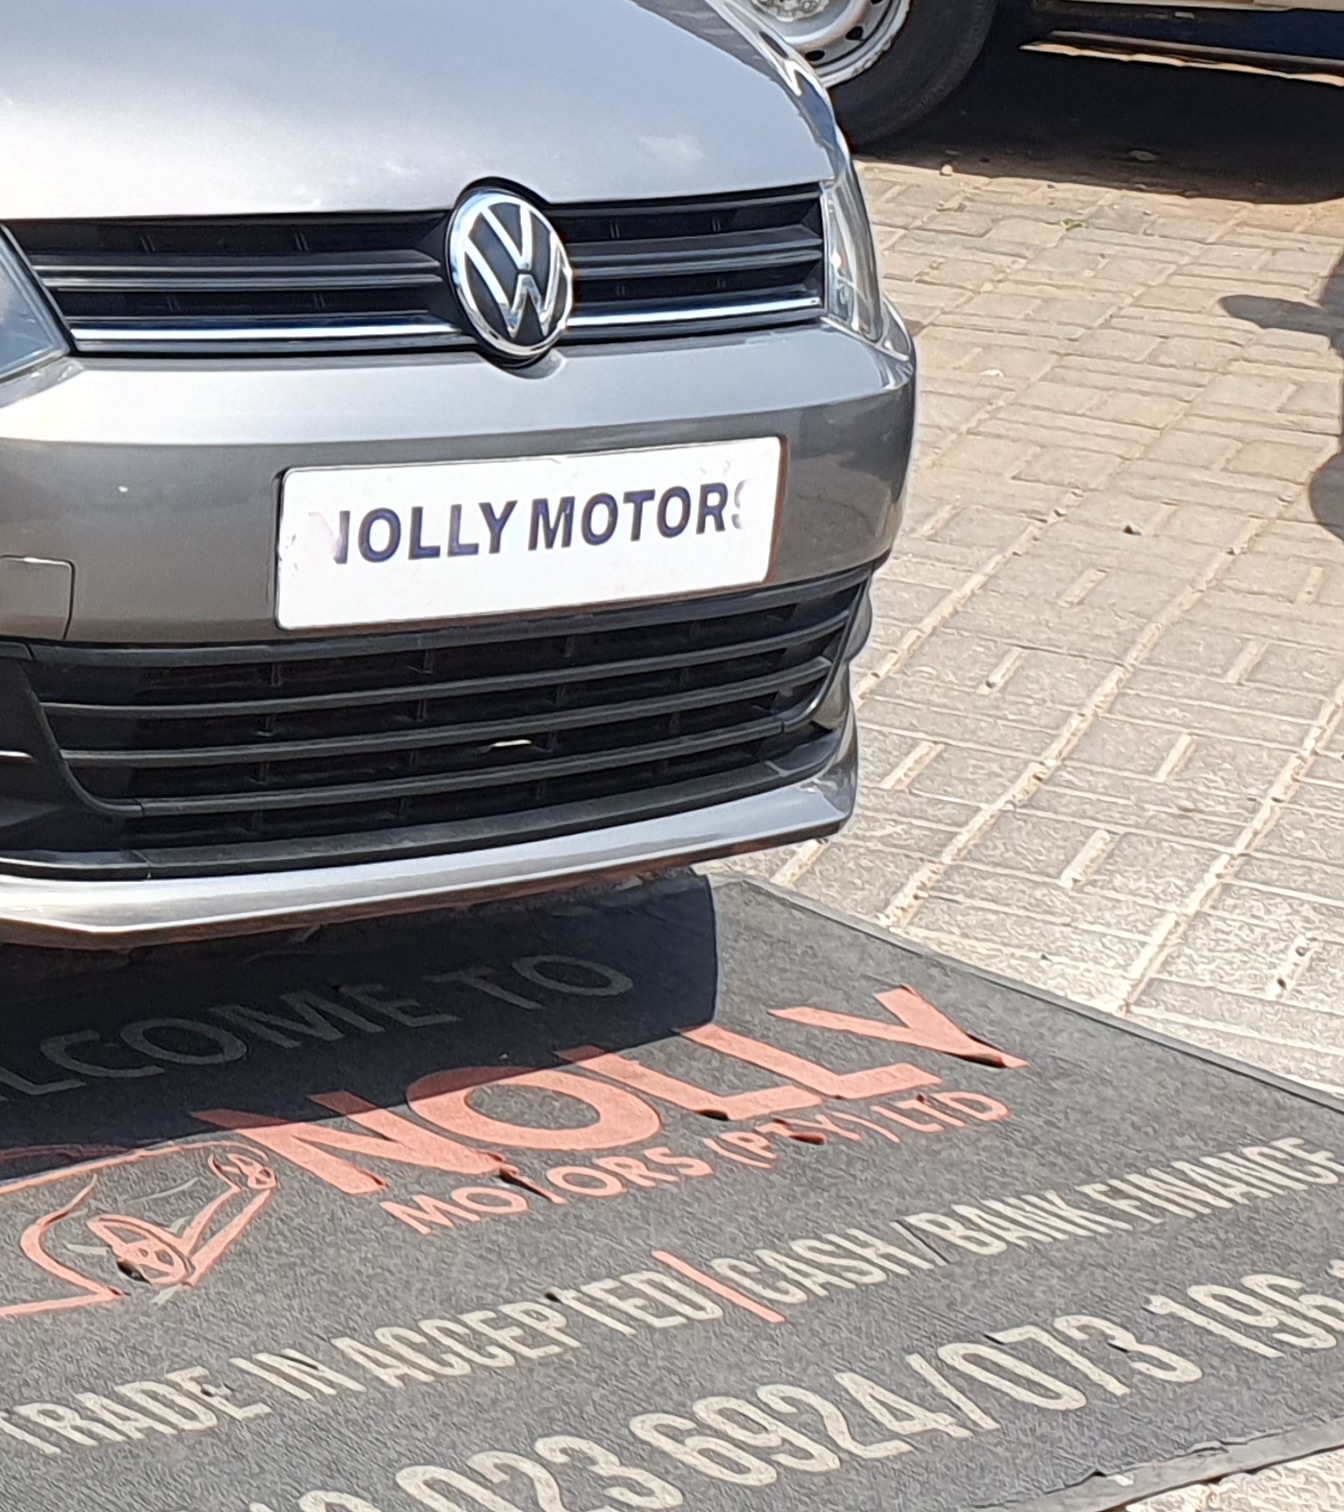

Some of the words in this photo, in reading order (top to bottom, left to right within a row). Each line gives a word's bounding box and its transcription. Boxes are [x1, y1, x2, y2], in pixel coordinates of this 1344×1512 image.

[423, 952, 632, 1011] TO
[189, 982, 1029, 1197] NOLLY
[379, 1146, 714, 1236] MOTORS
[870, 1091, 1009, 1133] LTD
[228, 1348, 368, 1400] IN
[1075, 1136, 1344, 1225] FINANCE
[1140, 1259, 1344, 1358] 196
